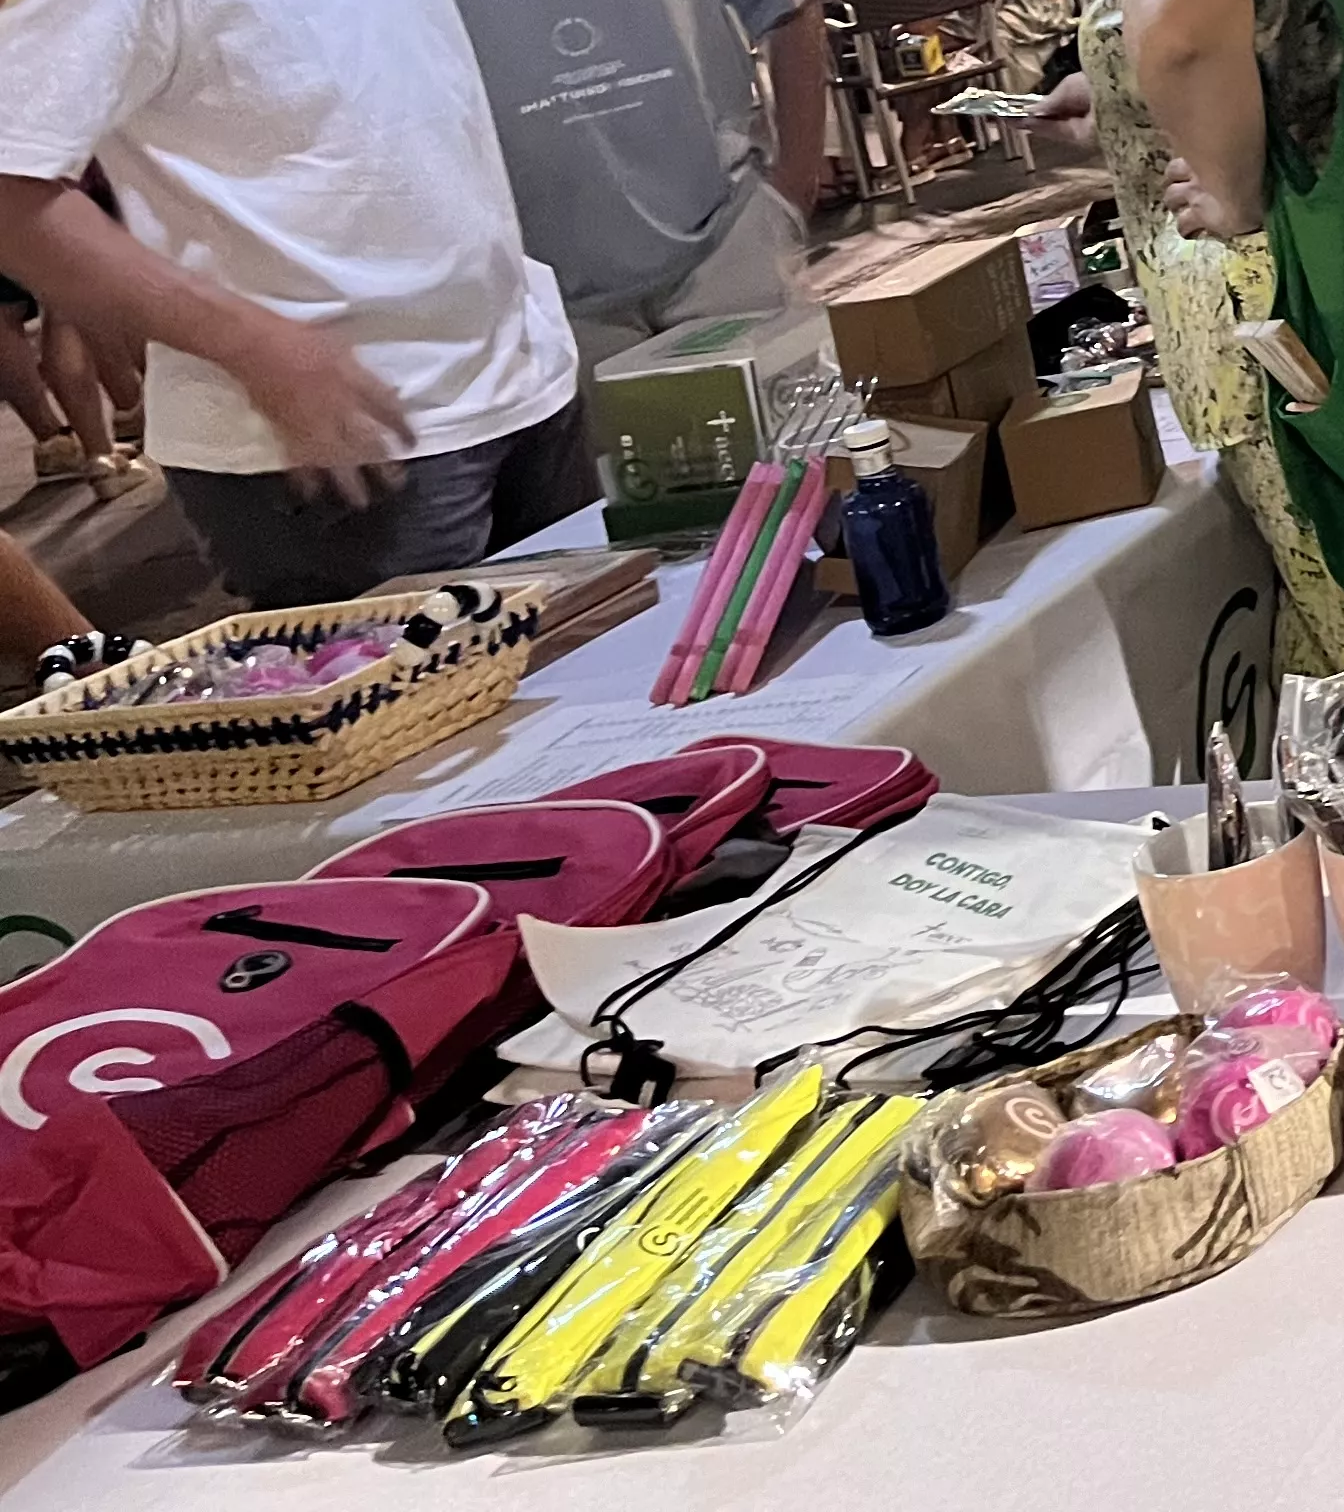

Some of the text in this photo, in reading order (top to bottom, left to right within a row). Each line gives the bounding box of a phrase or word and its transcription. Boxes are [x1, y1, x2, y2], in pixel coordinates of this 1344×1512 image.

[925, 852, 1013, 890] CONTIGO,
[888, 873, 1014, 919] DOY LA CARA
